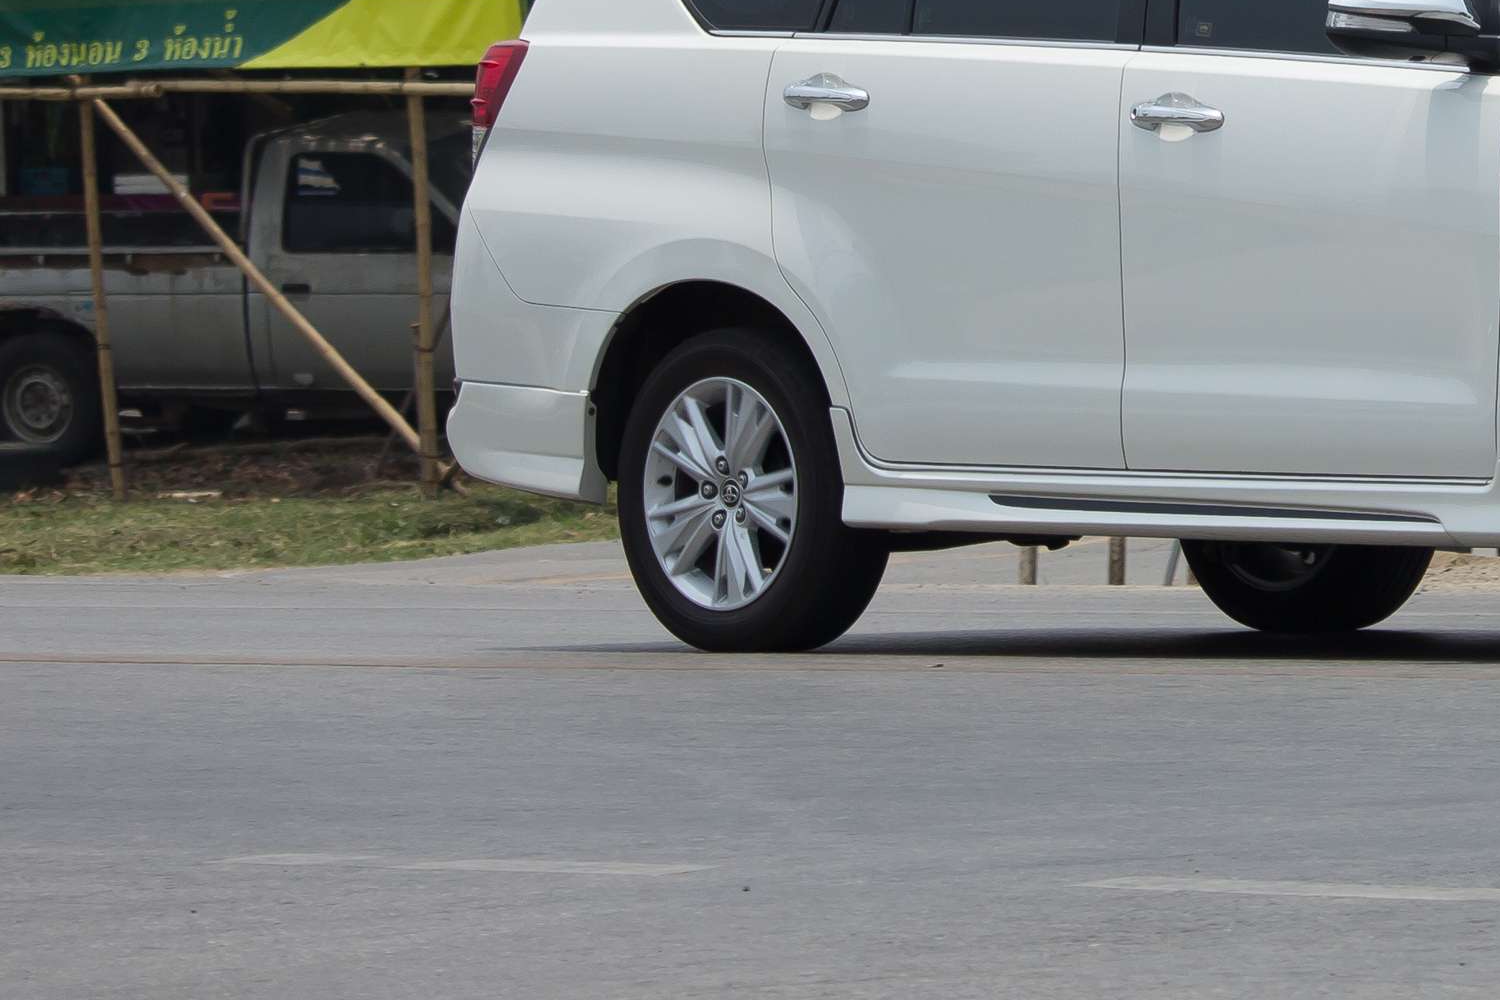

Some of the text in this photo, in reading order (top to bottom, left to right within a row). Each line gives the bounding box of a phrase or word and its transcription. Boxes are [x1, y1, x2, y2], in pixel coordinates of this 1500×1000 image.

[133, 39, 150, 63] 3
[164, 9, 244, 62] ห้องน้ำ
